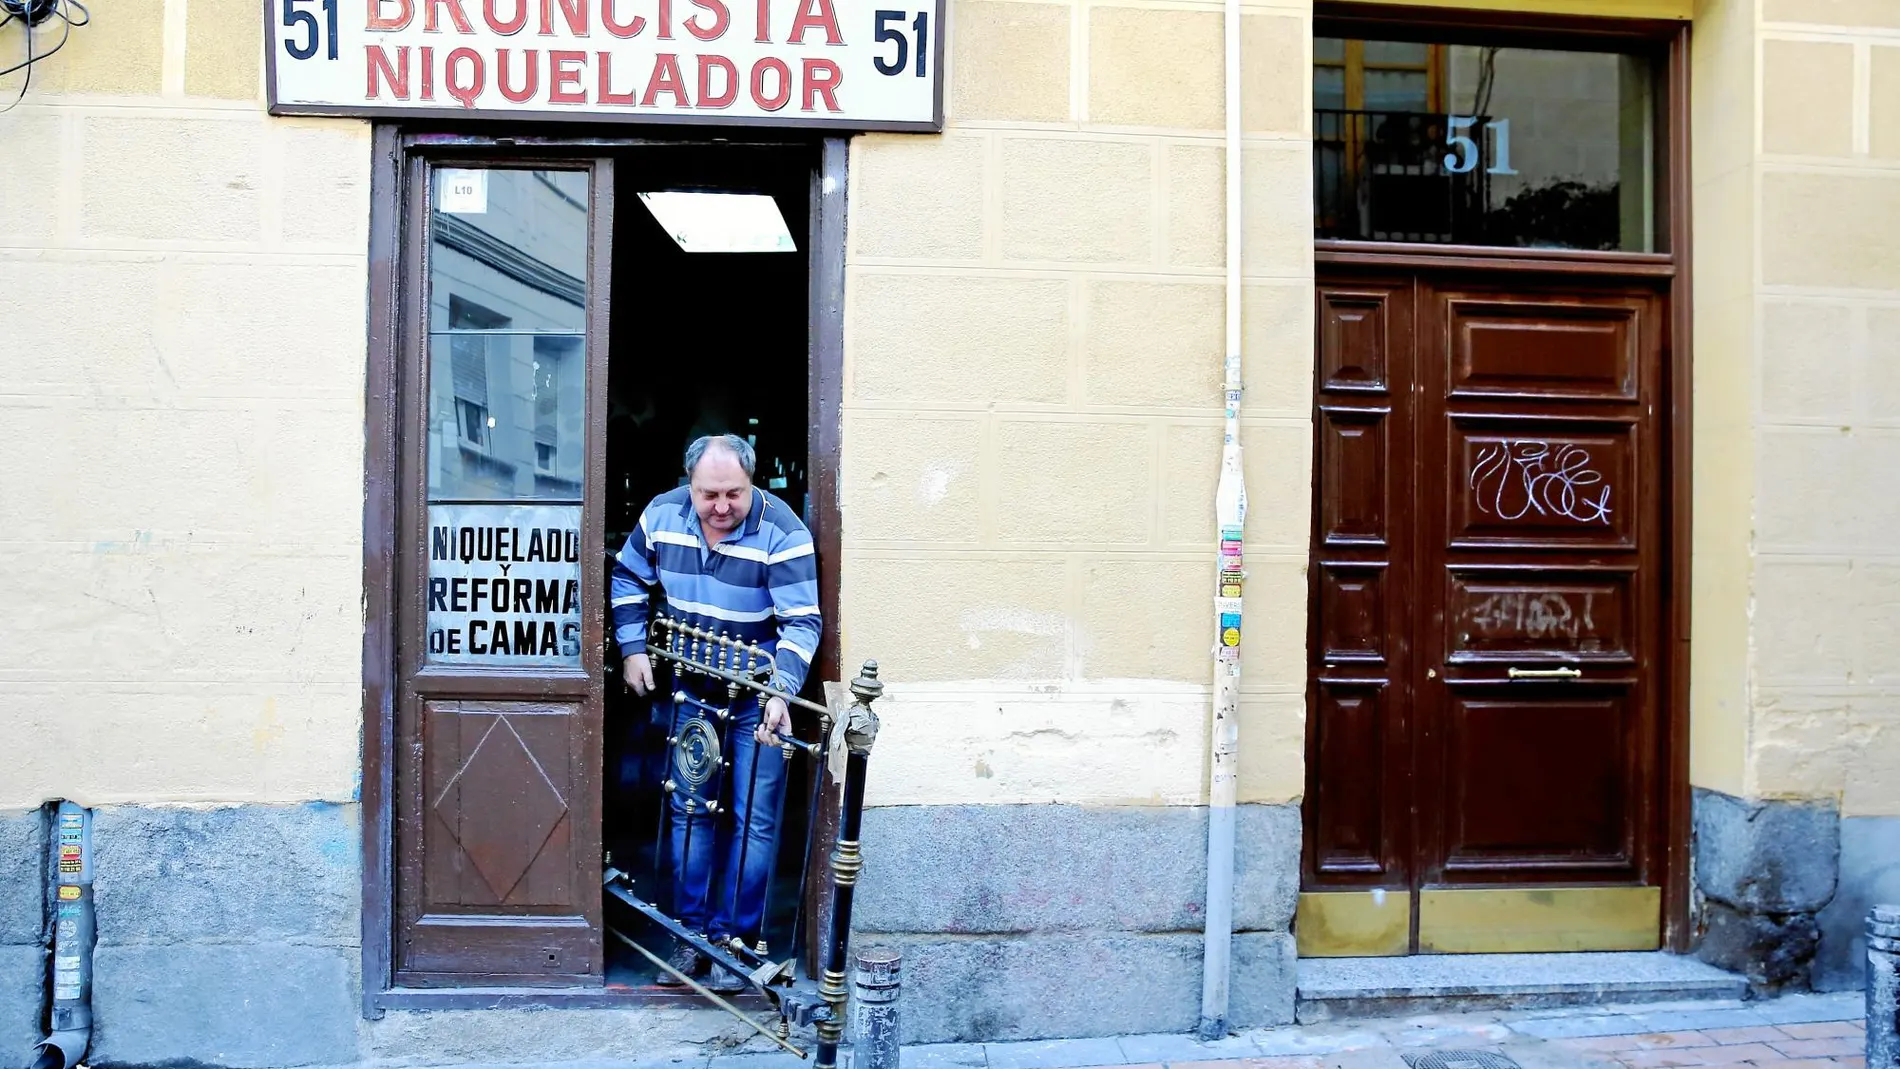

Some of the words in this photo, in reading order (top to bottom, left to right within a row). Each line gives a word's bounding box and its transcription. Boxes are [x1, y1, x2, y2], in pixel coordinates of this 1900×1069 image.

[283, 0, 338, 60] 51
[873, 10, 927, 77] 51
[364, 45, 845, 113] NIQUELADOR
[1444, 115, 1519, 175] 51
[455, 186, 472, 195] L10
[500, 564, 511, 576] Y
[429, 628, 461, 654] DE
[468, 620, 580, 657] CAMAS
